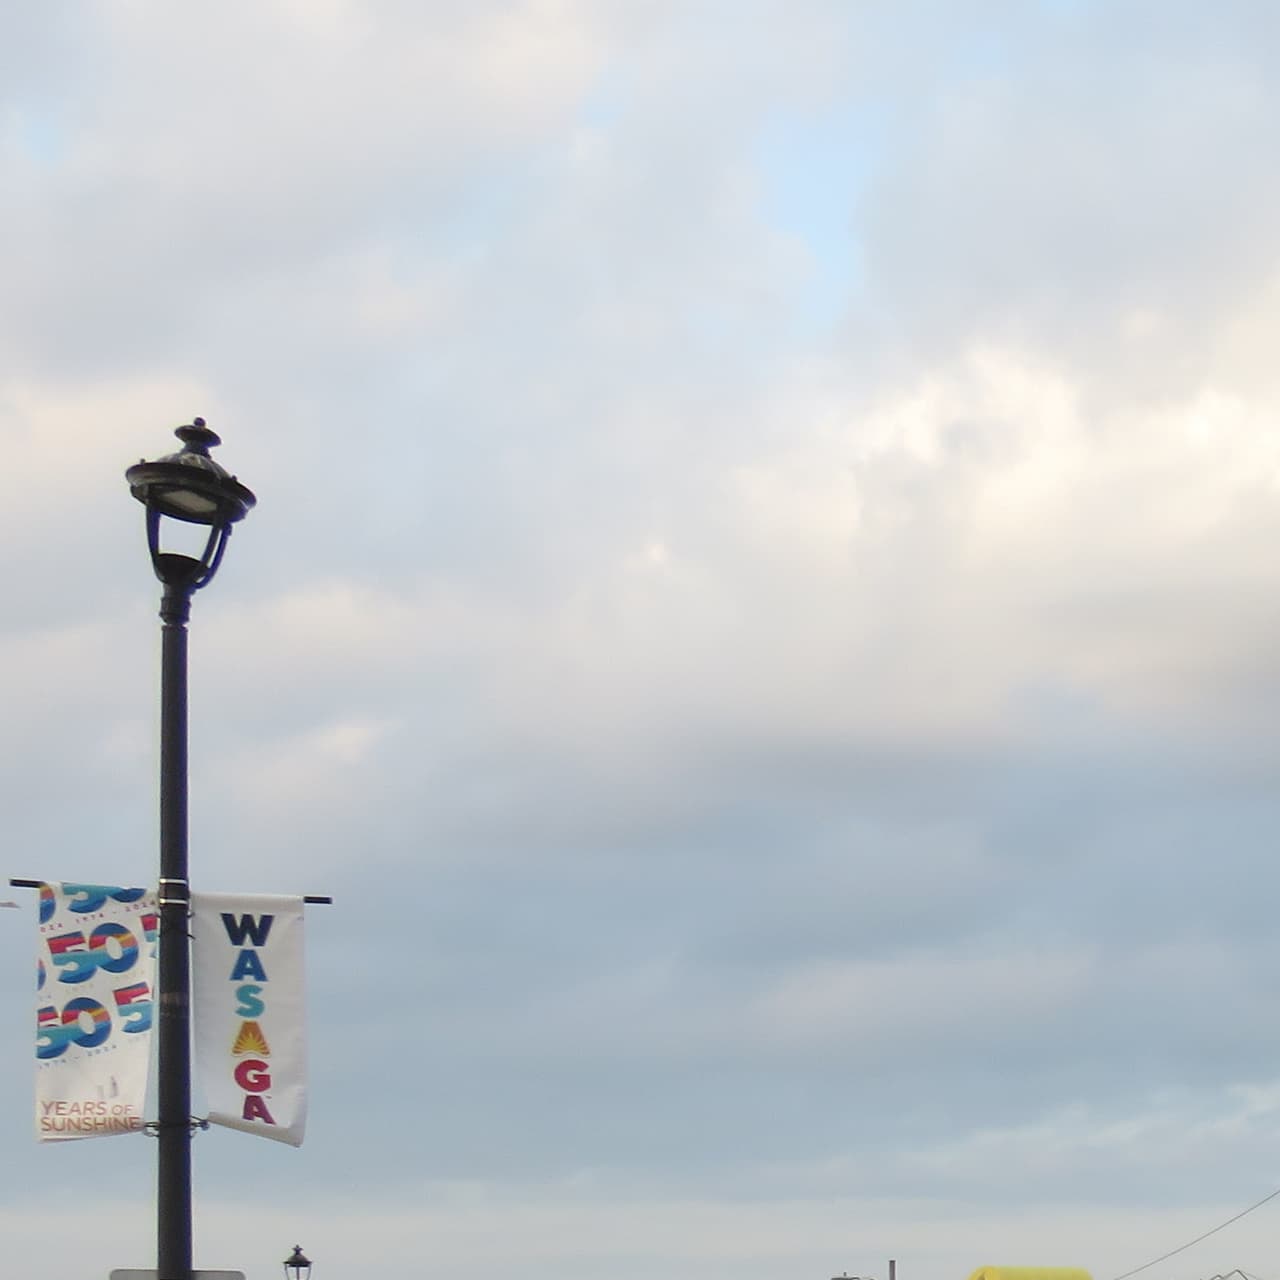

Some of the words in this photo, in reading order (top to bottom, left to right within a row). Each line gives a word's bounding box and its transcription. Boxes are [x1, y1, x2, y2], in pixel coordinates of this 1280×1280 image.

[46, 922, 140, 985] 50
[220, 912, 277, 1126] WASAGA
[41, 1100, 107, 1117] YEARS
[112, 1104, 134, 1116] OF
[41, 1116, 141, 1132] SUNSHINE
